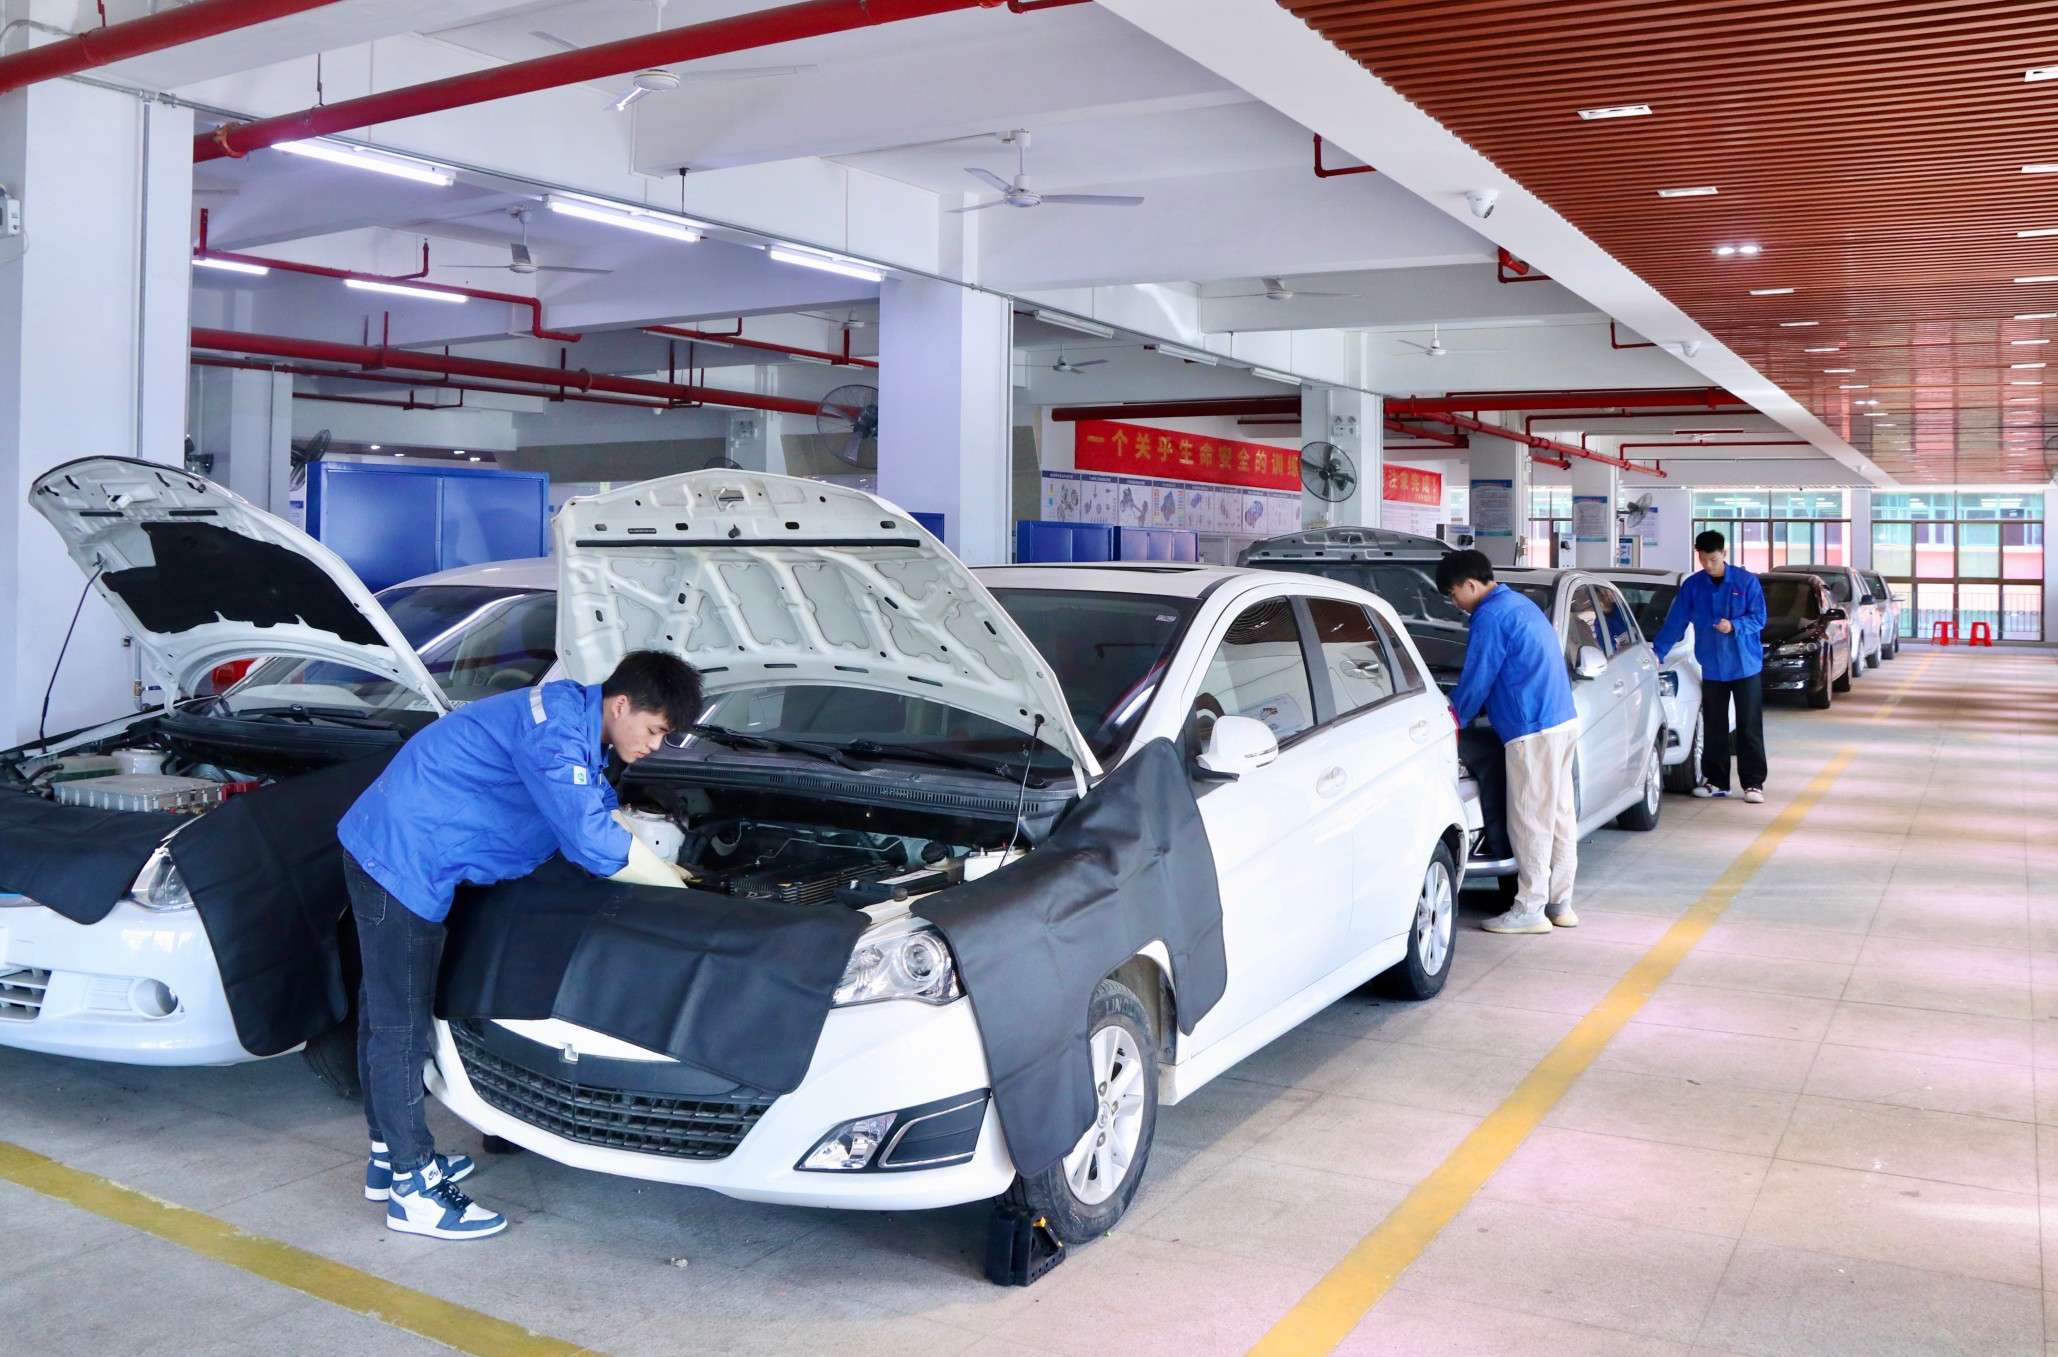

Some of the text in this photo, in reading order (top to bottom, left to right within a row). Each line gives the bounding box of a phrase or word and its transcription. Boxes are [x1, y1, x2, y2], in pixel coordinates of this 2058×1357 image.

[1087, 429, 1299, 478] 一个关乎生命安全的训练
